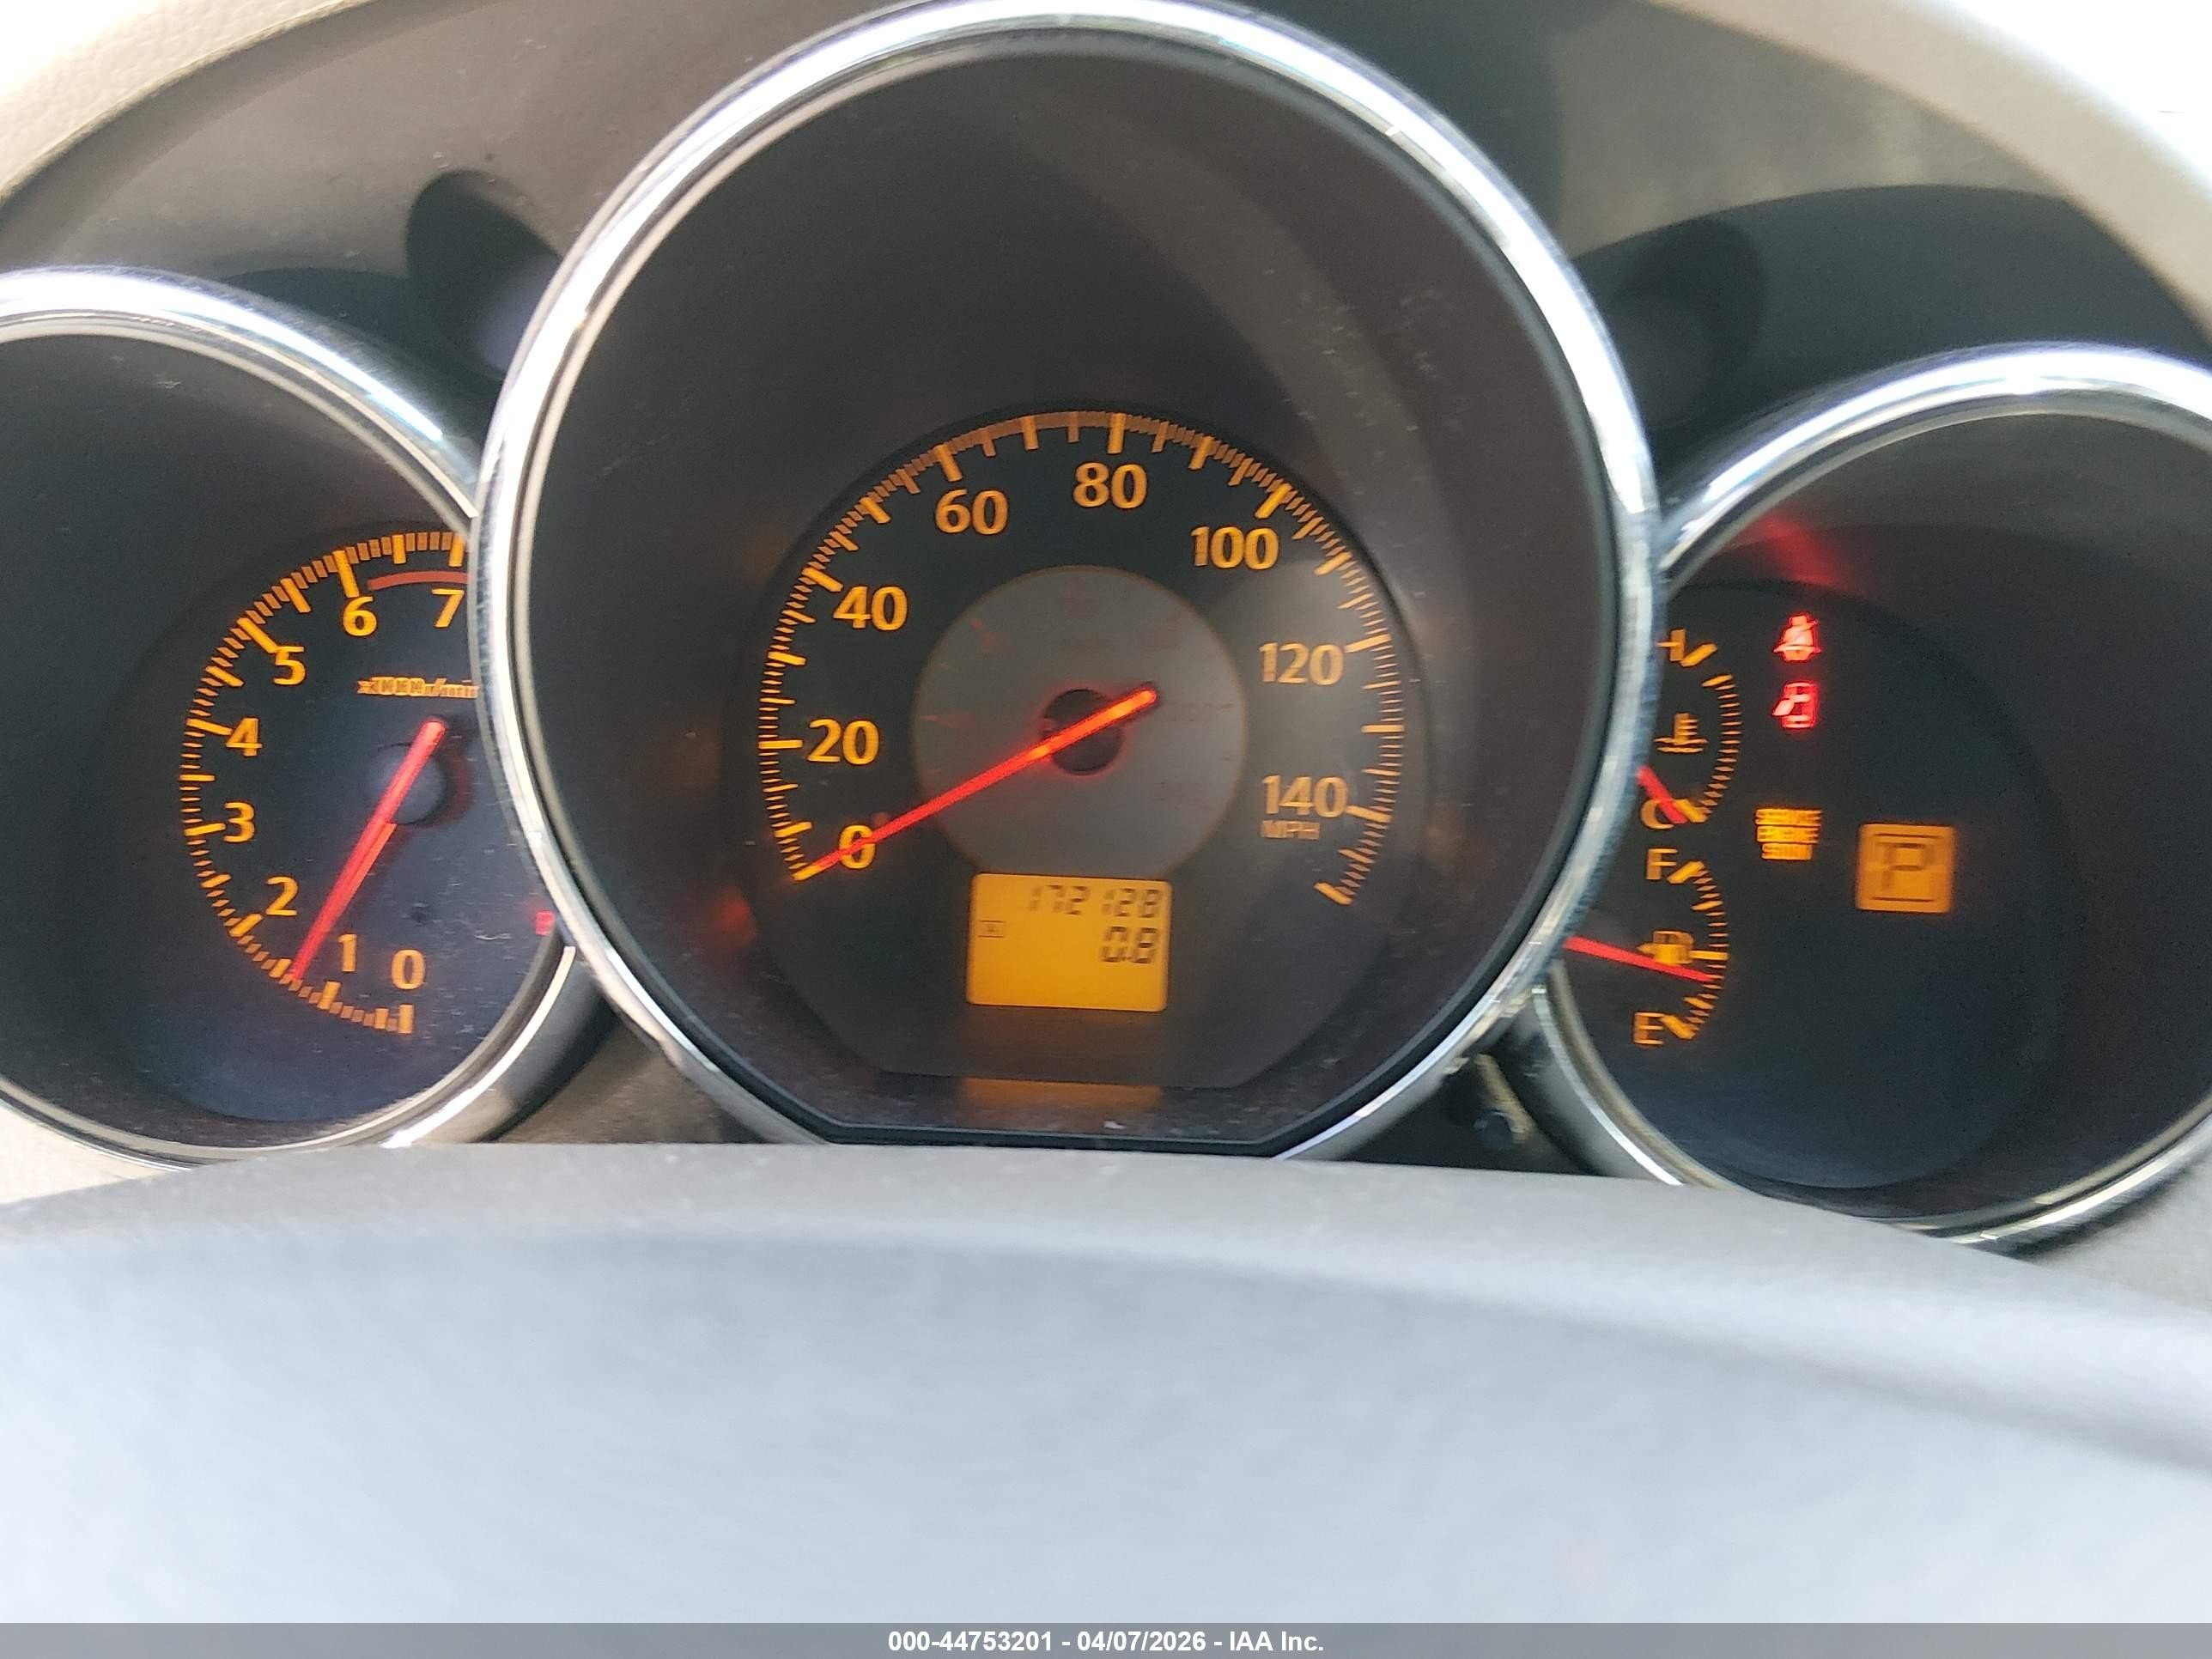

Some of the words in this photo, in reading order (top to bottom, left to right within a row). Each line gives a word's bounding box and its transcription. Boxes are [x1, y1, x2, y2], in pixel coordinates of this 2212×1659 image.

[1073, 462, 1148, 508] 80
[935, 489, 1008, 534] 60
[1190, 526, 1279, 569] 100
[343, 596, 377, 636] 6
[433, 588, 465, 628] 7
[832, 586, 908, 630] 40
[274, 647, 306, 686] 5
[1260, 642, 1344, 685] 120
[226, 718, 262, 756] 4
[807, 719, 879, 764] 20
[1262, 775, 1347, 817] 140
[224, 802, 255, 842] 3
[1262, 819, 1320, 840] MPH
[838, 824, 876, 869] 0
[1645, 848, 1678, 881] F
[266, 876, 298, 916] 2
[1029, 884, 1161, 917] 172128
[338, 933, 357, 972] 1
[392, 948, 426, 990] 0
[1634, 1012, 1667, 1045] E
